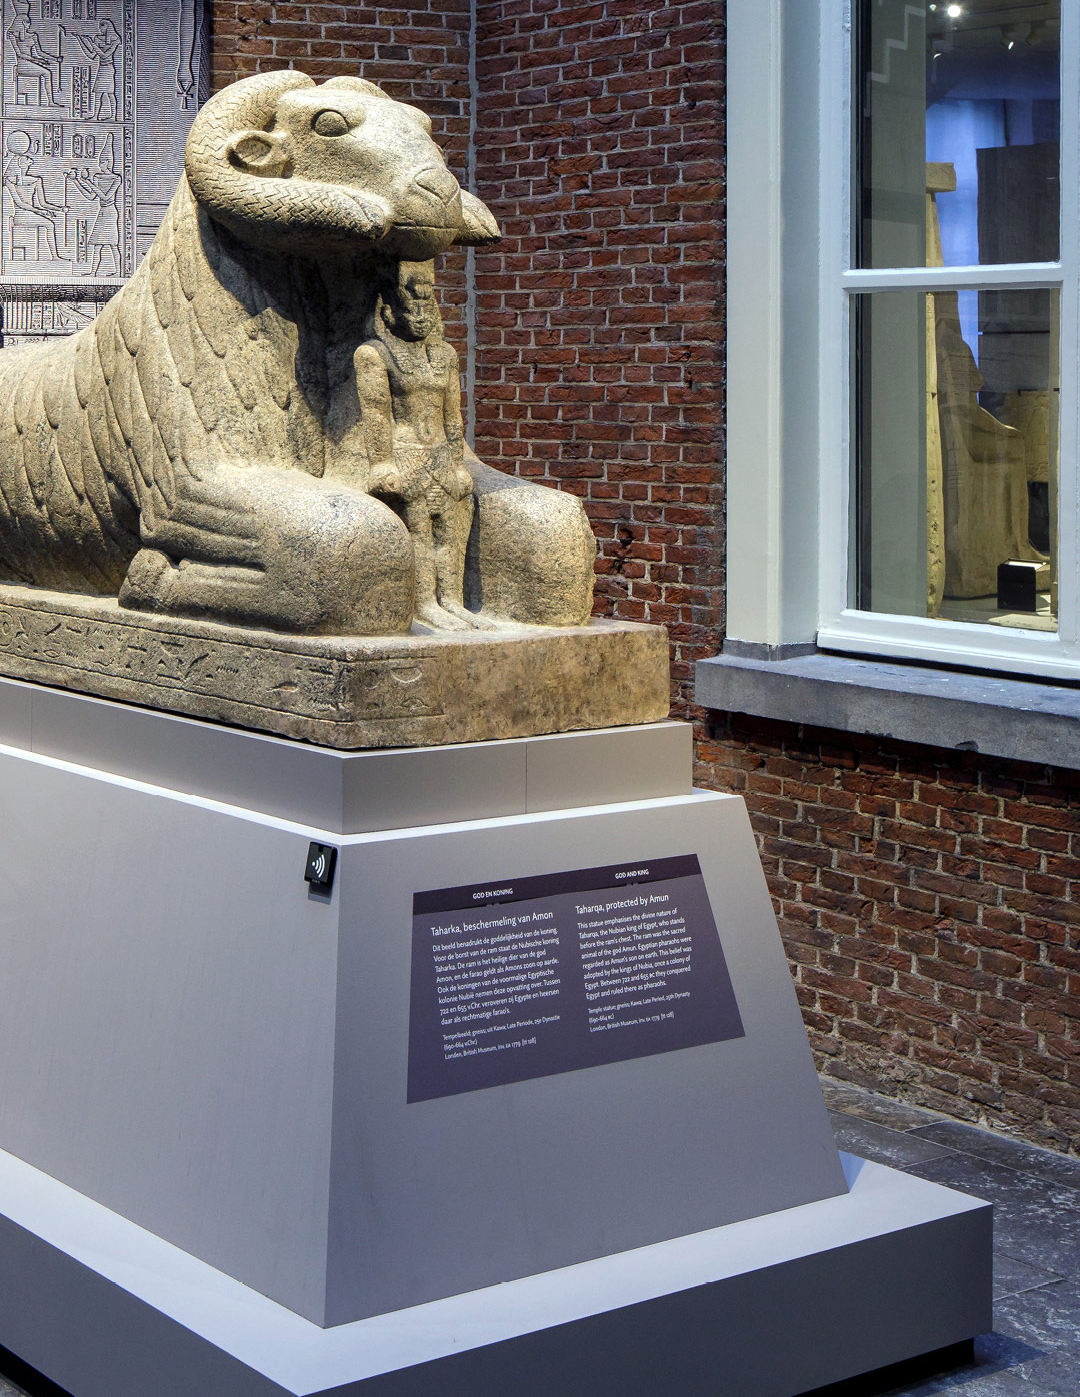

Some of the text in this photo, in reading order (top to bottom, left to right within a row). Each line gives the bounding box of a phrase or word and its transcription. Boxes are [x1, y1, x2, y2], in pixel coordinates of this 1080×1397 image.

[493, 888, 513, 896] KONING
[575, 894, 669, 914] Taharqa, protected by Amun
[430, 912, 553, 936] Taharka, beschermeling van Amon
